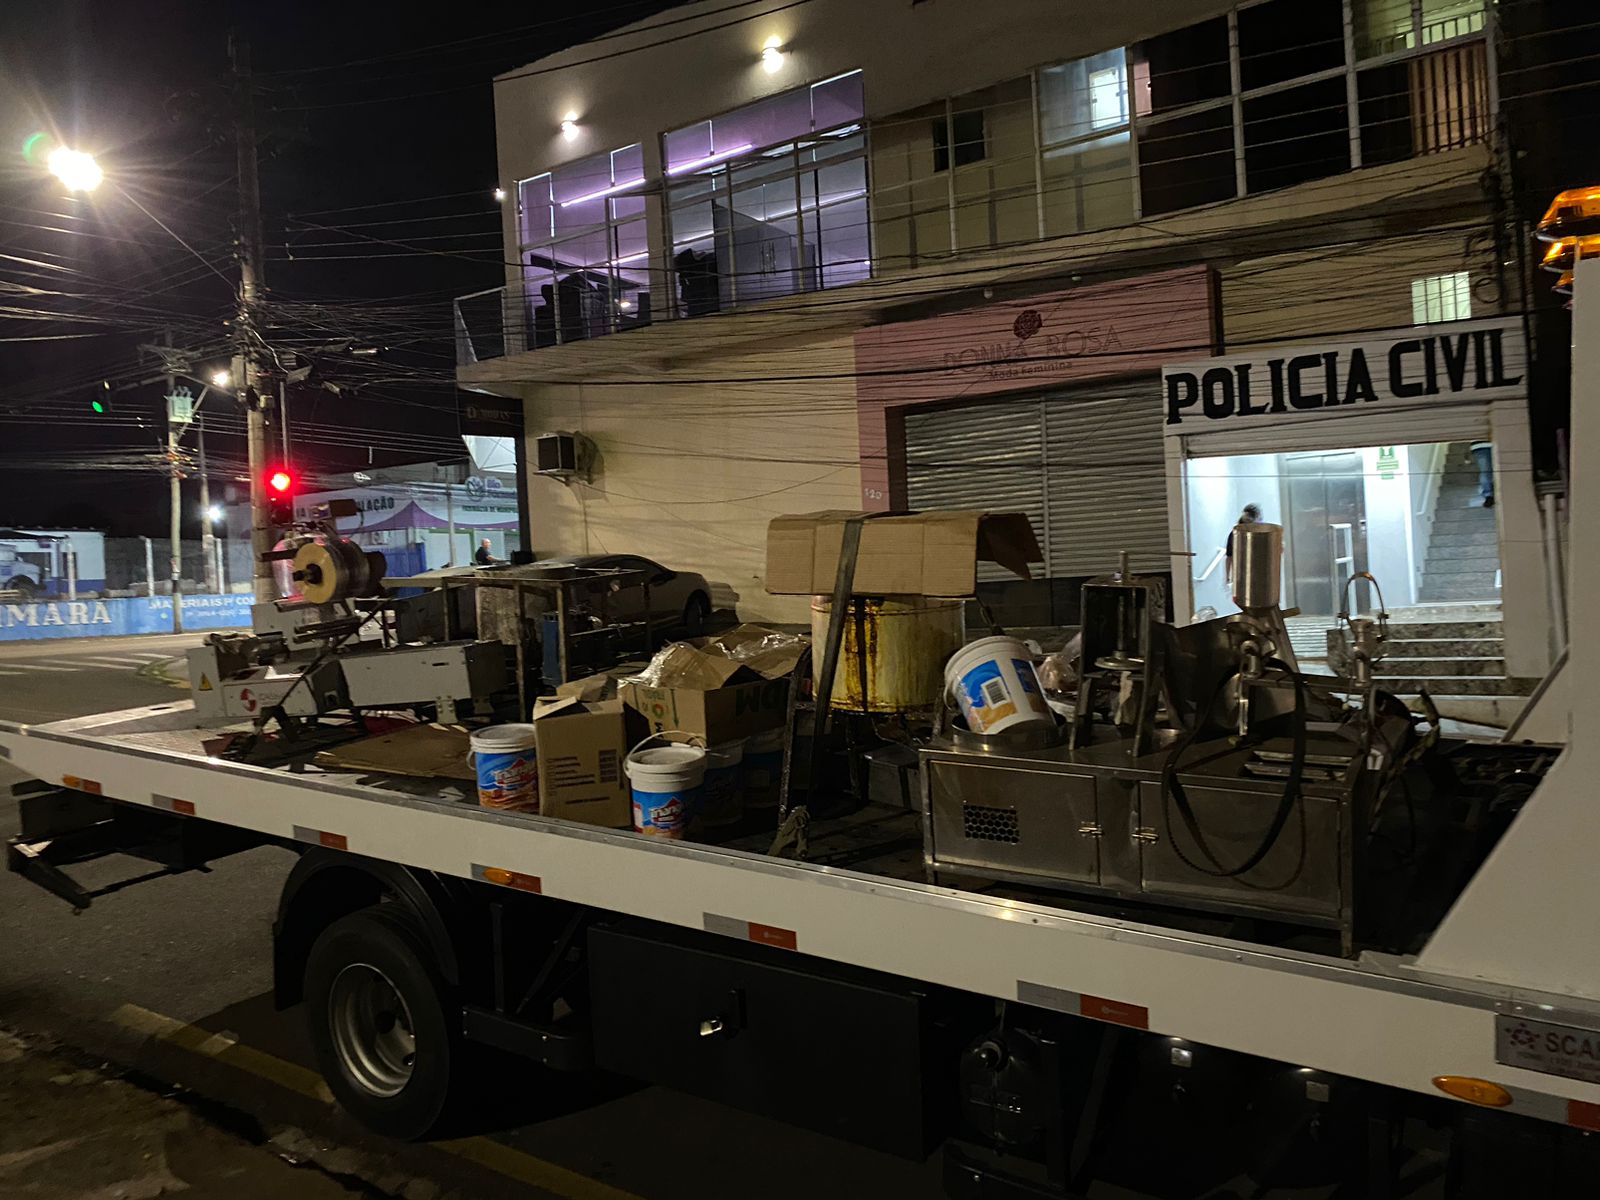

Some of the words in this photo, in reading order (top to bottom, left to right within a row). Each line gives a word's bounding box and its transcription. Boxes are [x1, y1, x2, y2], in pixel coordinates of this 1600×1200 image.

[1046, 325, 1122, 357] ROSA
[1165, 347, 1379, 425] POLICIA
[1388, 328, 1525, 398] CIVIL
[1545, 1032, 1600, 1061] SCA
